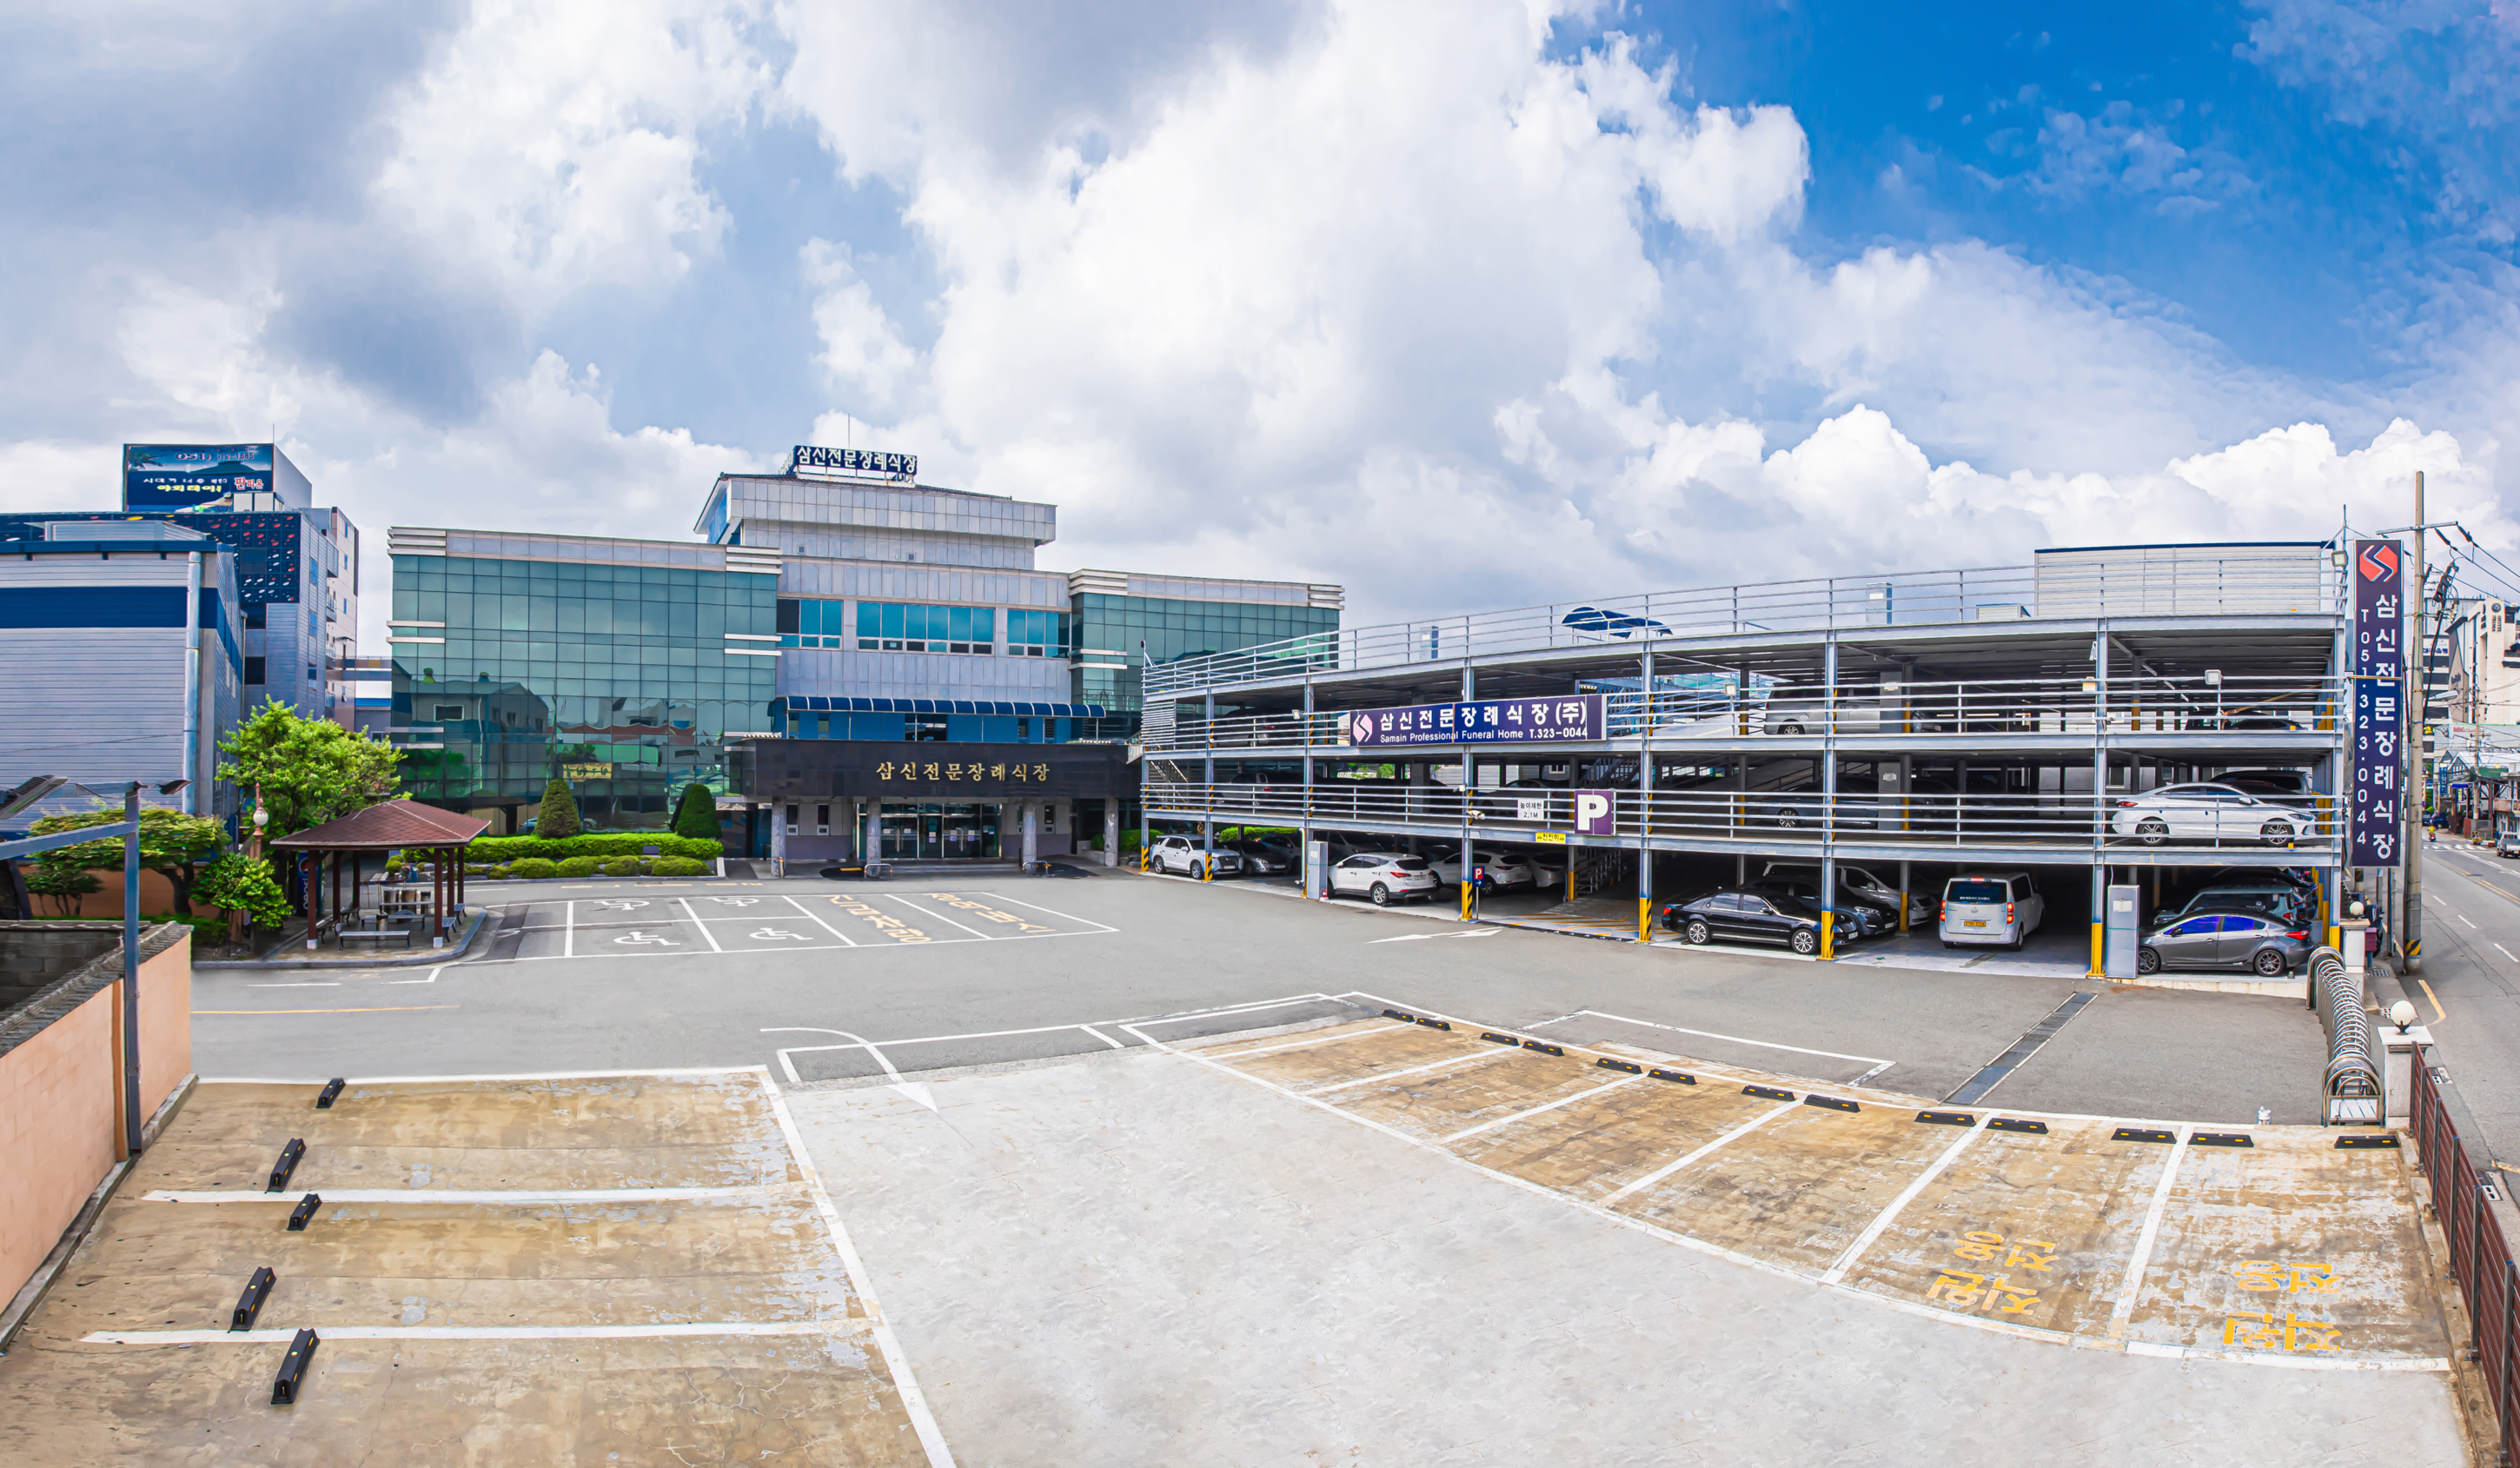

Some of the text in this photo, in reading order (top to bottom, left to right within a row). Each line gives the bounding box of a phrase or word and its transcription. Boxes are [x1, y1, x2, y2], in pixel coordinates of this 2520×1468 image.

[797, 446, 916, 474] 삼신전문장례식장
[1380, 727, 1588, 743] Samsin Professional Funeral Home T.323-0044
[2373, 595, 2398, 860] 삼신전문장례식장
[876, 761, 1050, 781] 삼신전문장례식장
[1577, 794, 1608, 831] P
[1476, 868, 1482, 879] P
[1954, 1231, 2059, 1272] 전용
[1926, 1268, 2041, 1315] 직원
[2237, 1259, 2342, 1294] 전용
[2224, 1312, 2343, 1352] 직원
